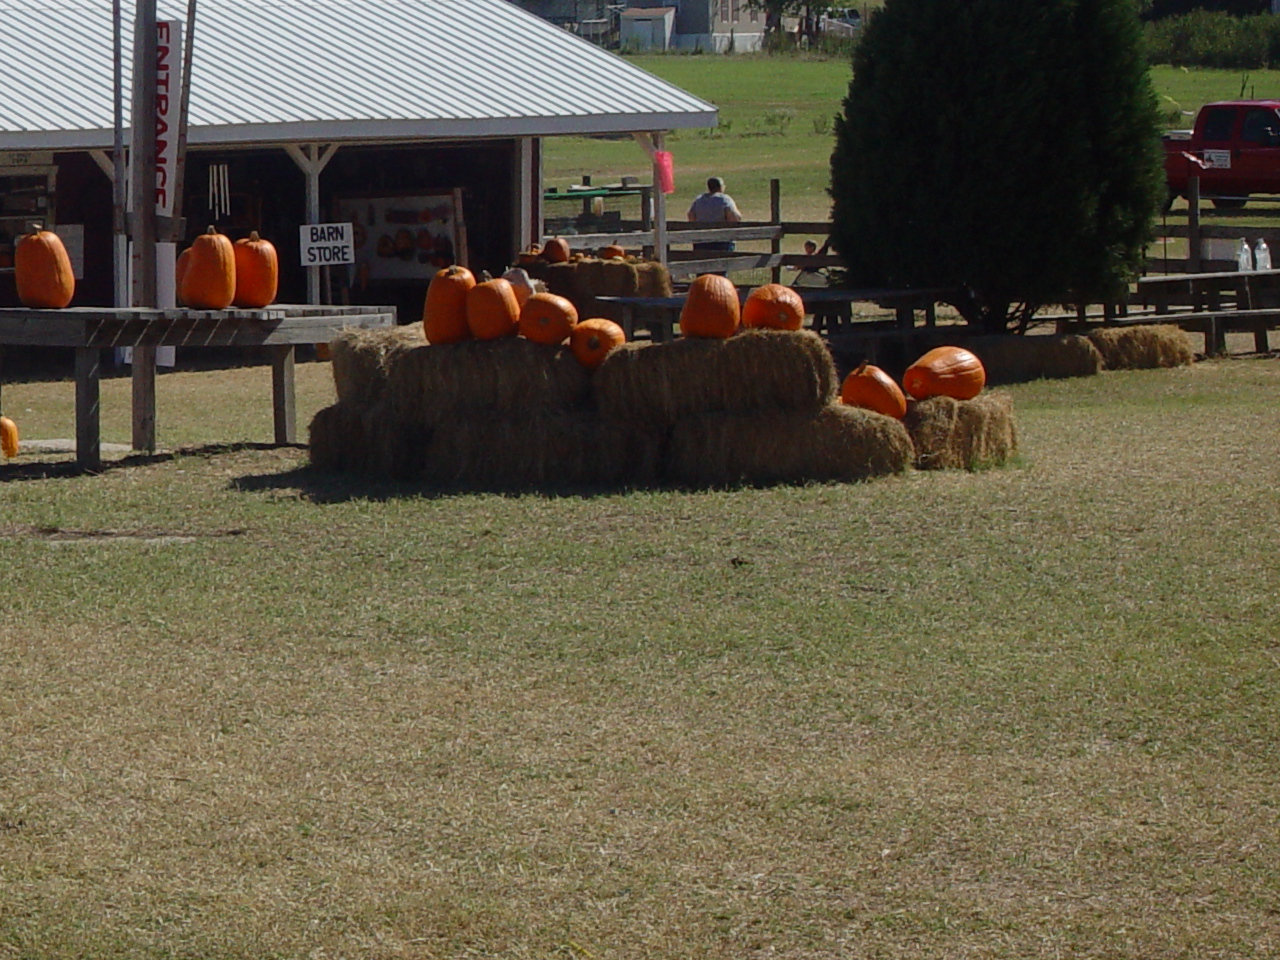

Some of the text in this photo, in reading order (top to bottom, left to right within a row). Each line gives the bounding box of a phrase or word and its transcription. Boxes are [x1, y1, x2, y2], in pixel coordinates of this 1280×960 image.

[155, 22, 170, 209] ENTRANCE
[310, 225, 344, 243] BARN
[307, 245, 350, 263] STORE
